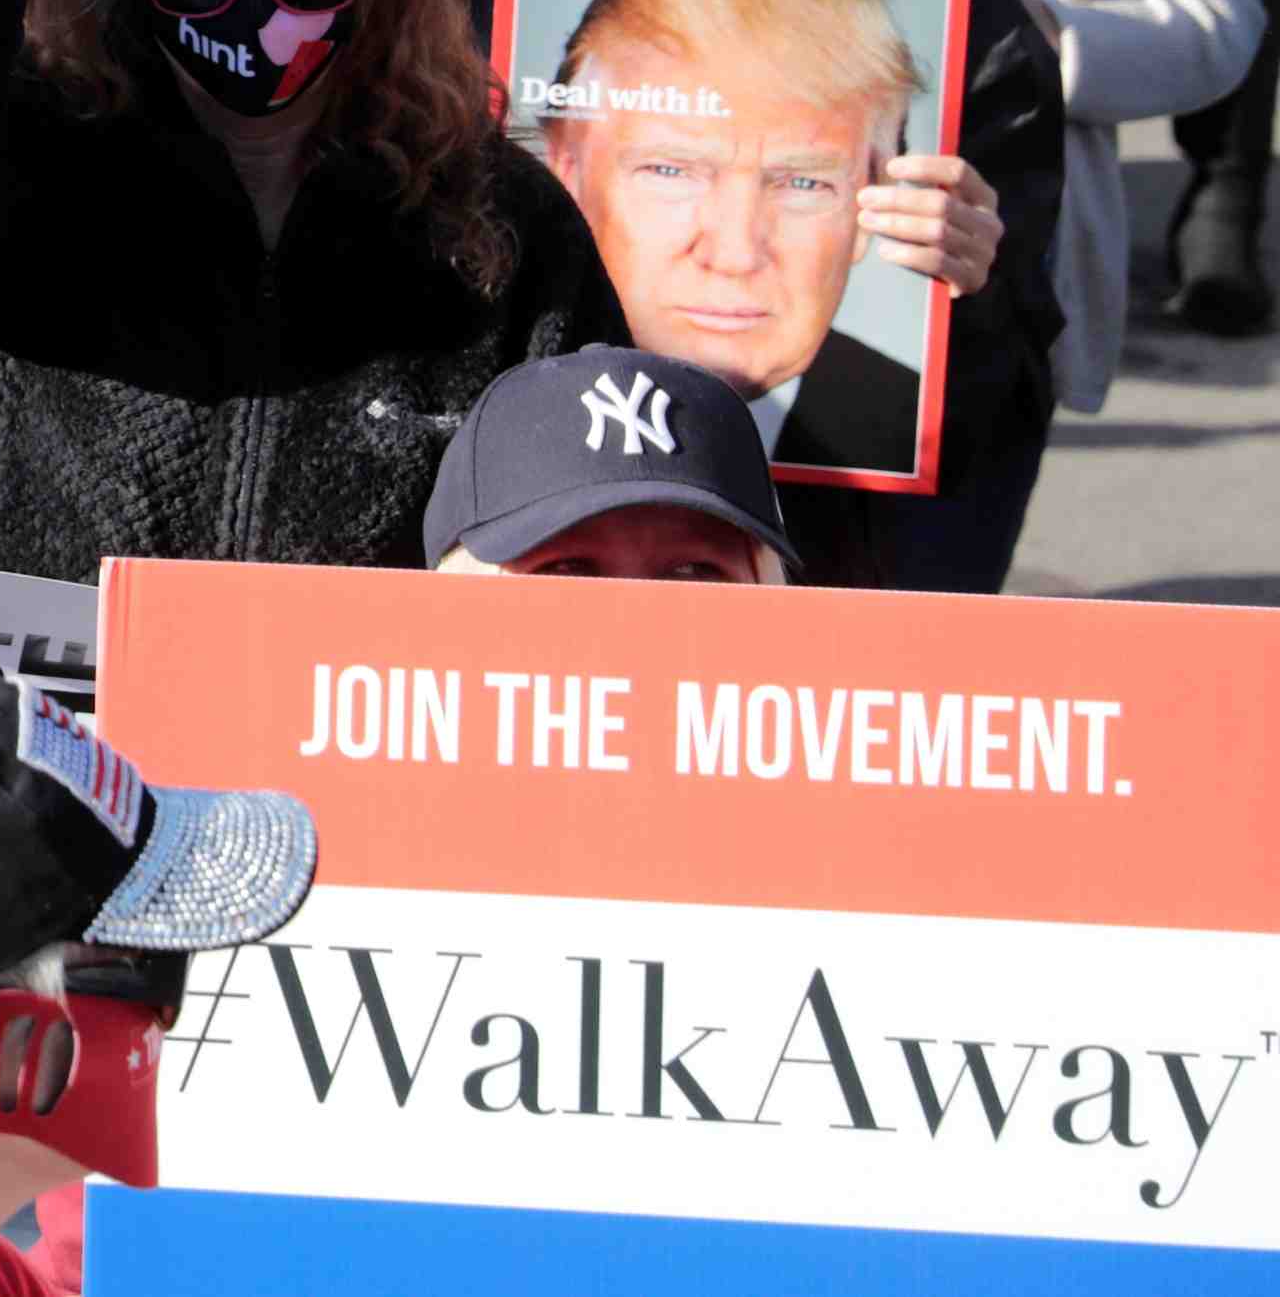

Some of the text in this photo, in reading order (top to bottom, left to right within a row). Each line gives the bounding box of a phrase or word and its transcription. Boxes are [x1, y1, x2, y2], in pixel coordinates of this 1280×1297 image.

[178, 16, 256, 79] hint
[520, 76, 732, 119] Deal with it.
[580, 370, 676, 455] NY
[298, 662, 1134, 797] JOIN THE MOVEMENT.
